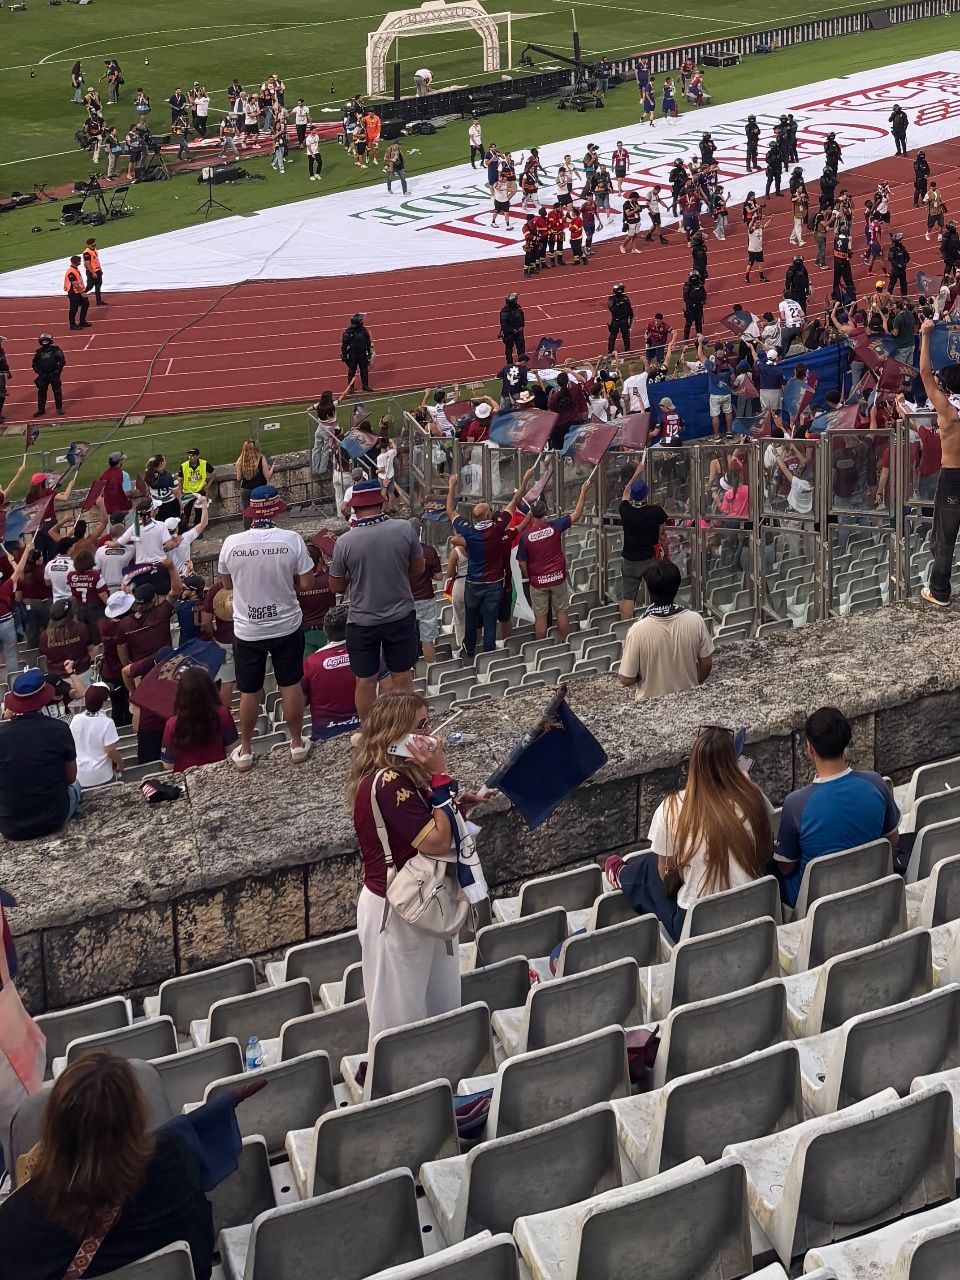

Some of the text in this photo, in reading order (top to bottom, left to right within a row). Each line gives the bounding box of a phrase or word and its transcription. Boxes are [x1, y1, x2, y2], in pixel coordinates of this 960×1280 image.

[789, 307, 801, 319] 23
[666, 424, 679, 438] 42
[232, 547, 289, 557] PORÃO VELHO
[75, 587, 88, 603] 7
[248, 603, 277, 614] torres
[248, 610, 278, 620] vedras
